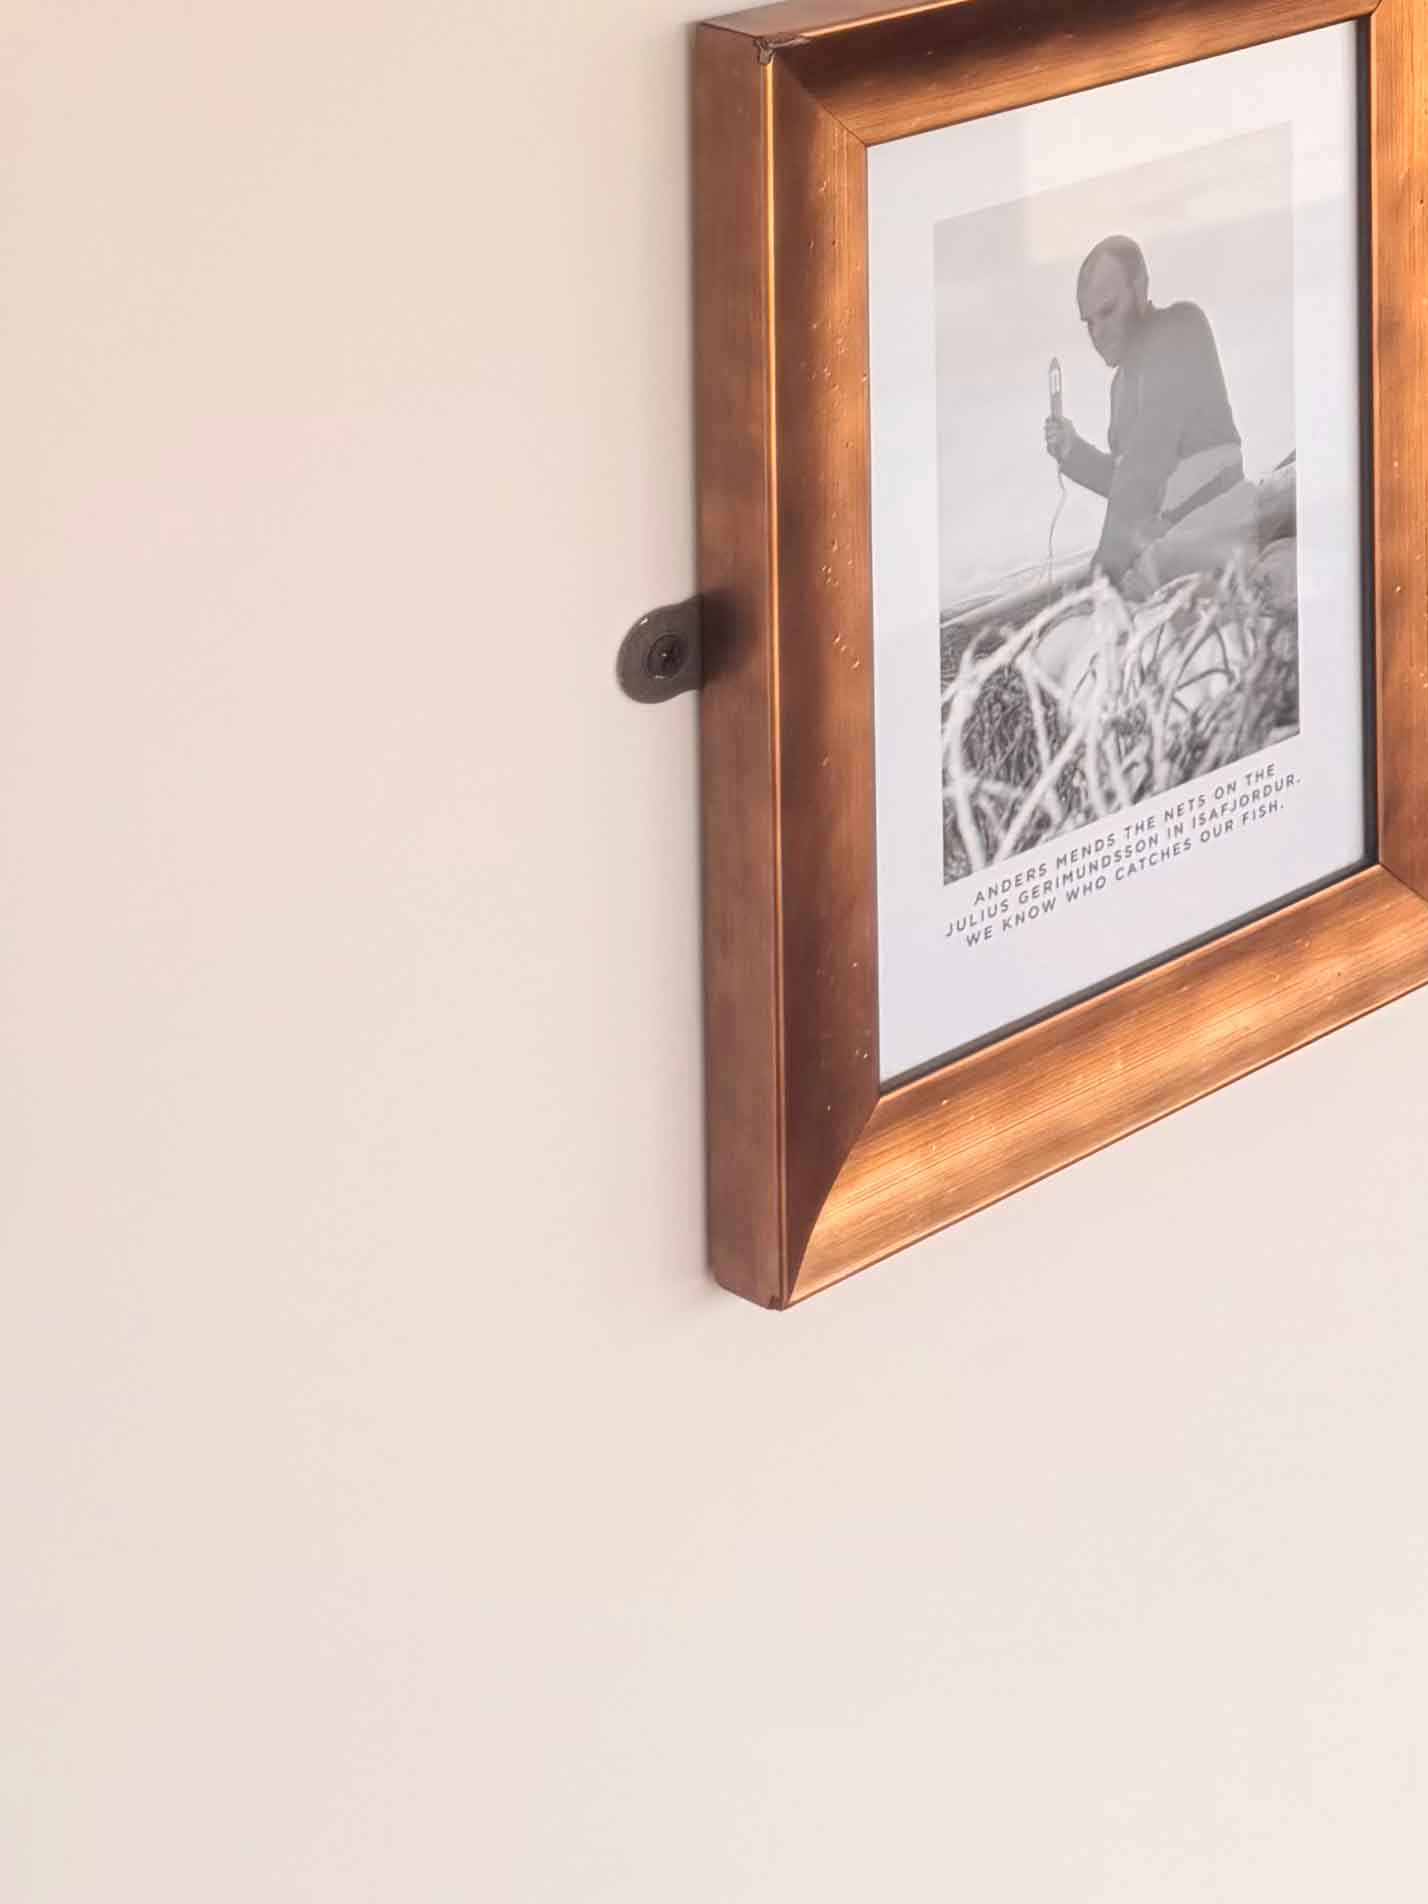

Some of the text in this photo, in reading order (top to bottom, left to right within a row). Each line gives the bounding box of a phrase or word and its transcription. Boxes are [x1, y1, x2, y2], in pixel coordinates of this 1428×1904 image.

[945, 773, 1302, 937] JULIUS GERIMUNDSSON IN ISAFJORDUR.
[966, 799, 1285, 948] WE KNOW WHO CATCHES OUR FISH.
[974, 763, 1276, 906] ANDERS MENDS THE NETS ON THE
